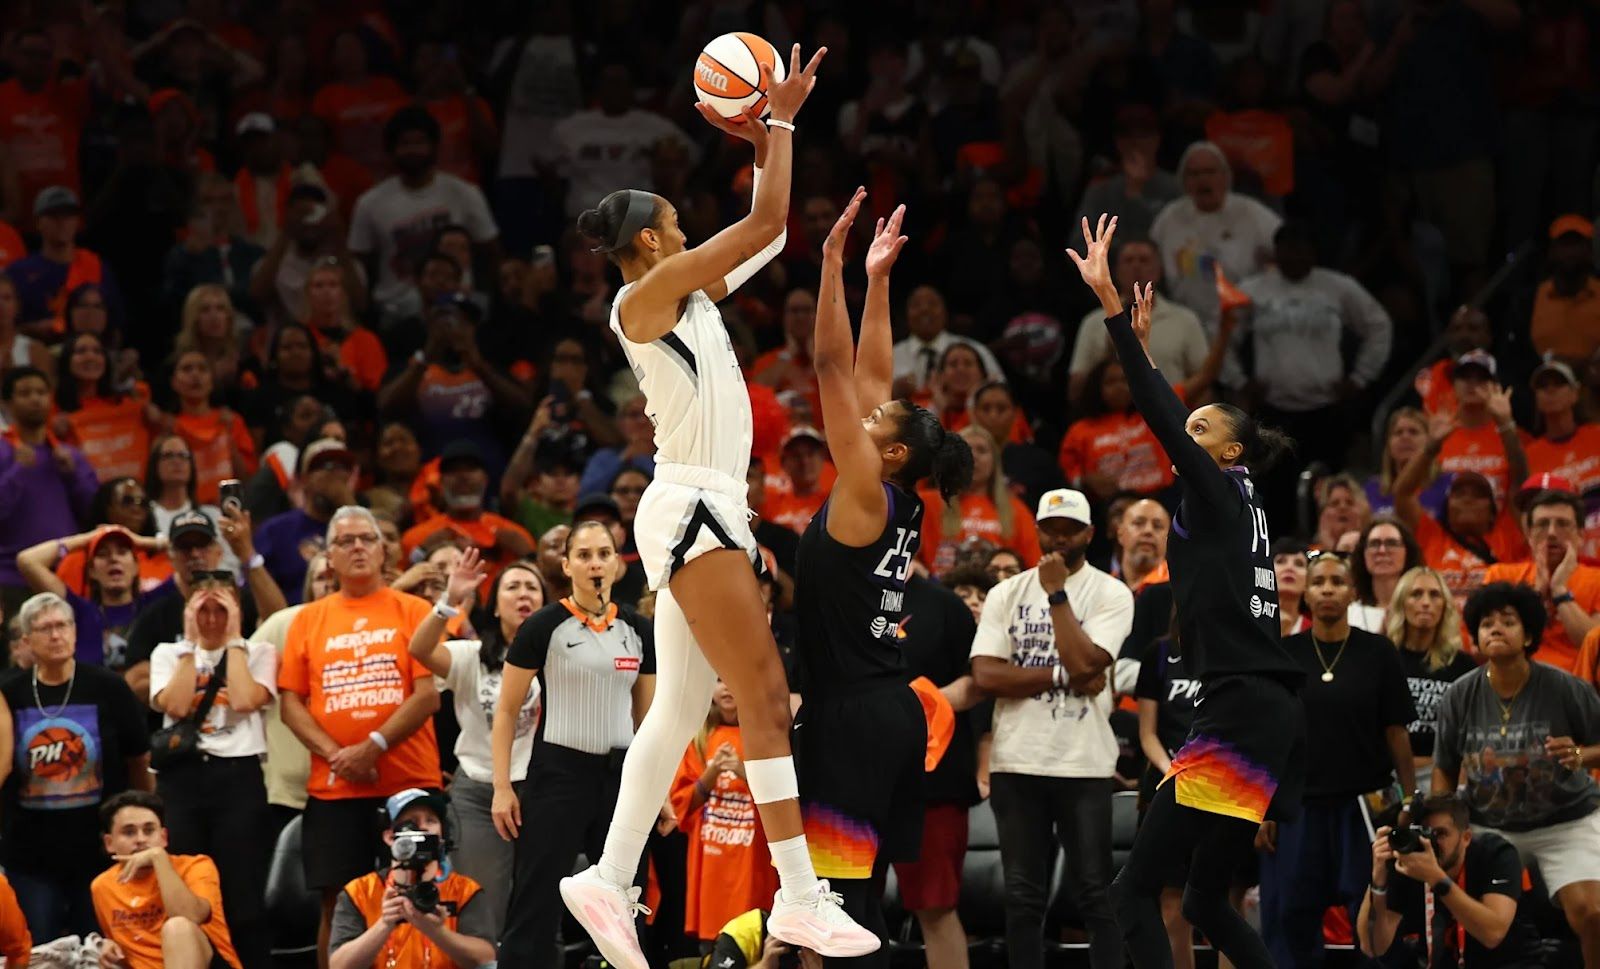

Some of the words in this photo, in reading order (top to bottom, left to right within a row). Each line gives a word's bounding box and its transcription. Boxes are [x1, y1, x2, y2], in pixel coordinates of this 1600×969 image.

[1248, 504, 1270, 557] 14
[874, 527, 918, 581] 25
[880, 589, 905, 612] THOMA
[1018, 605, 1031, 620] If
[1023, 619, 1053, 635] just
[325, 628, 397, 652] MERCURY
[325, 688, 404, 713] EVERYBODY
[30, 741, 64, 769] PH
